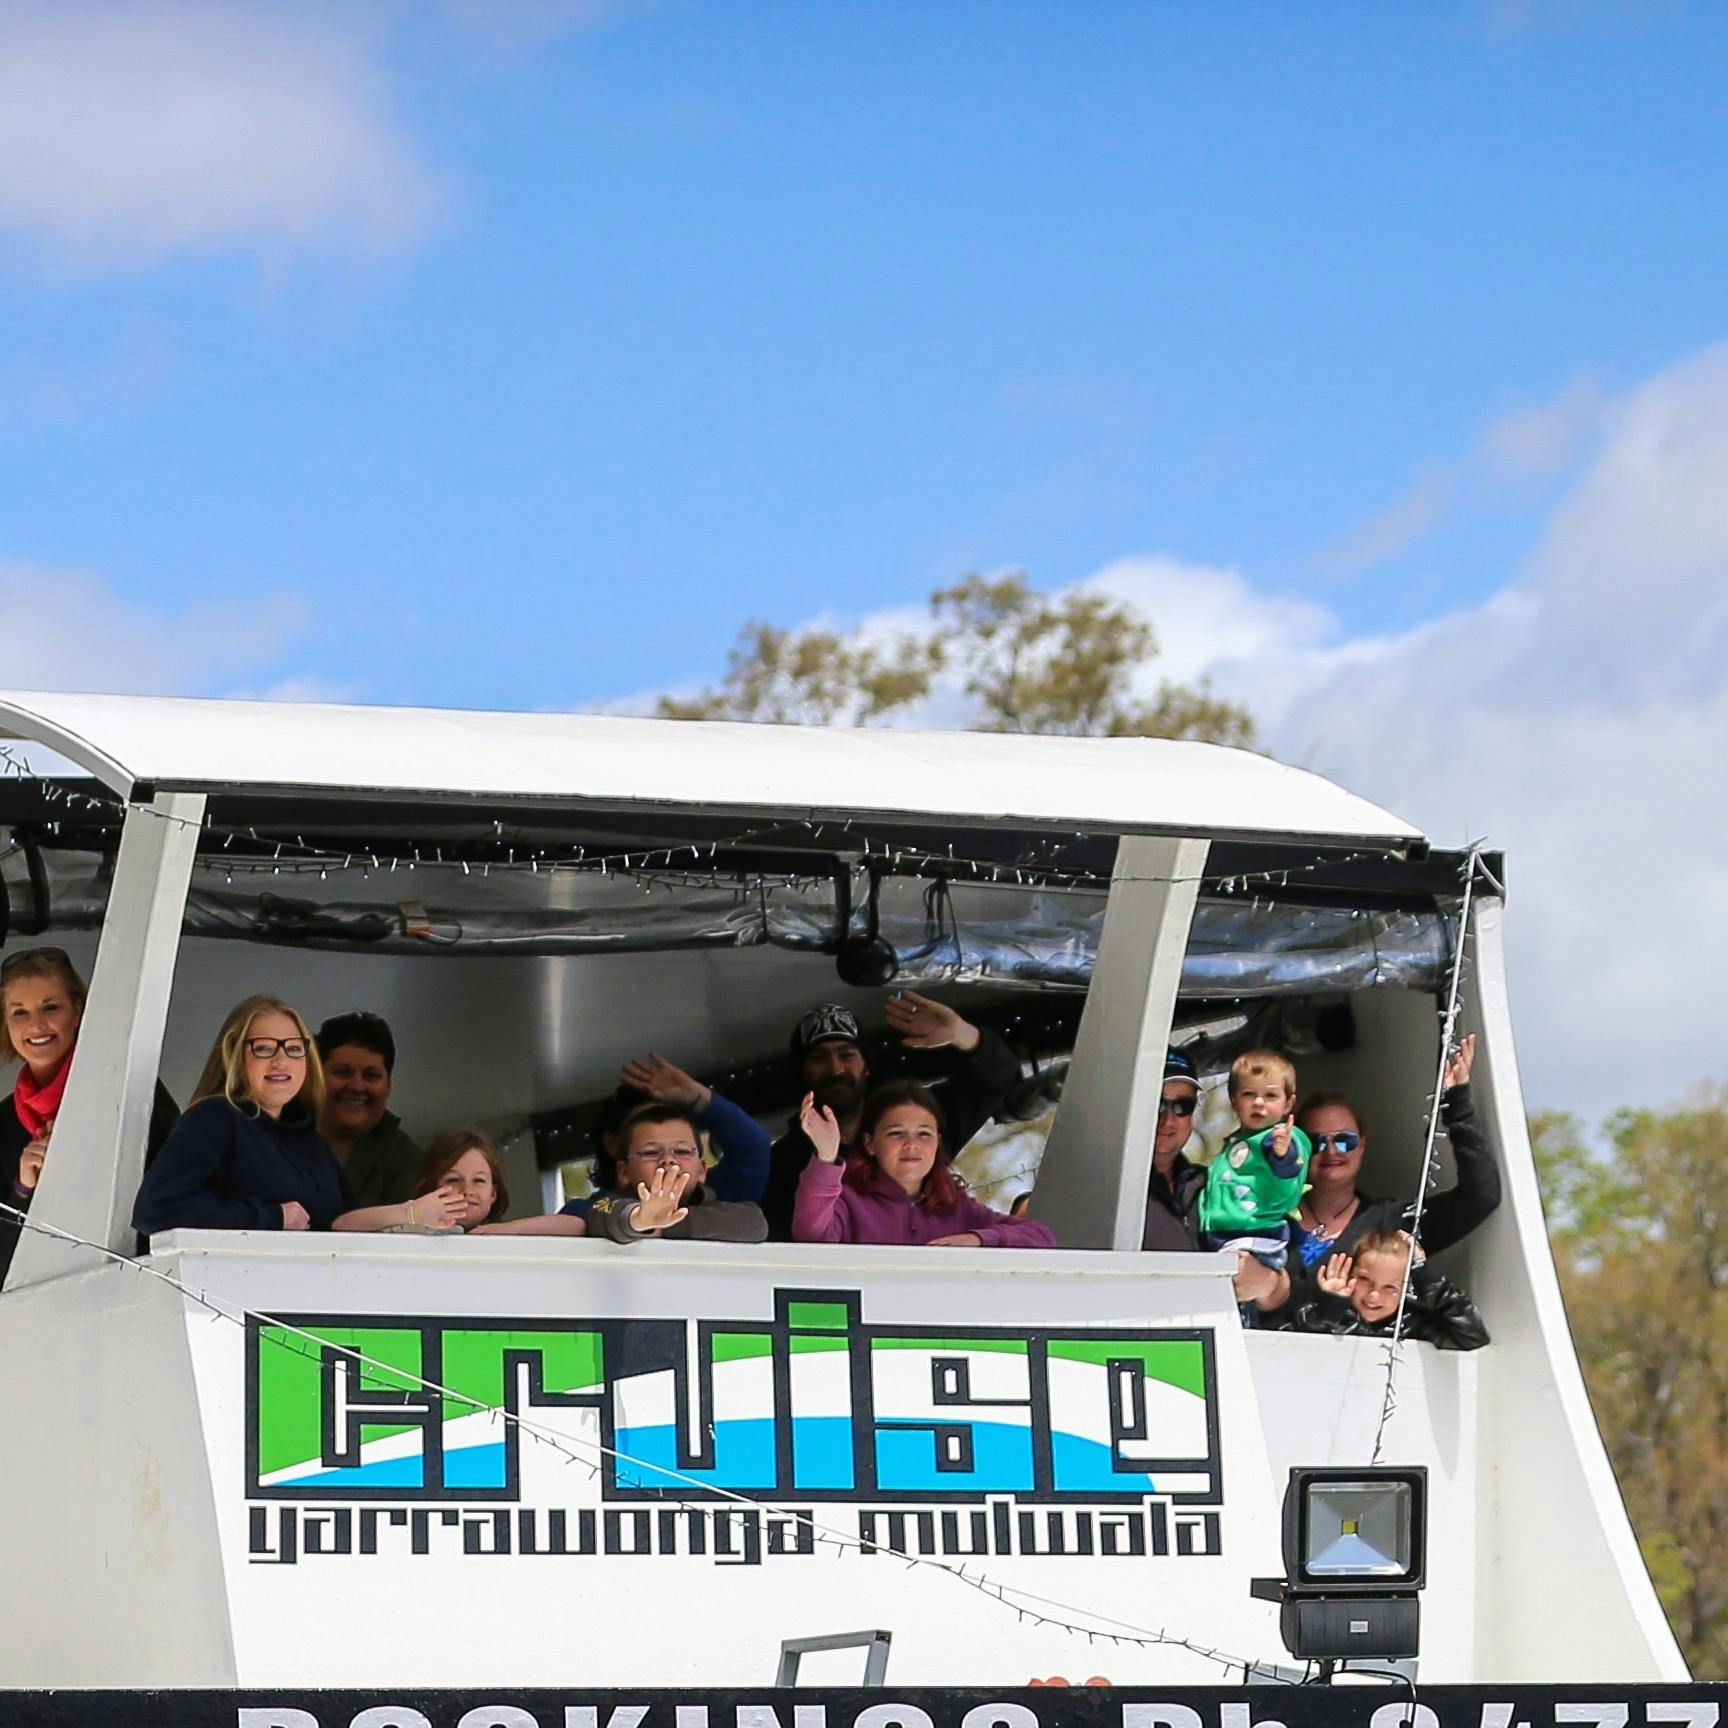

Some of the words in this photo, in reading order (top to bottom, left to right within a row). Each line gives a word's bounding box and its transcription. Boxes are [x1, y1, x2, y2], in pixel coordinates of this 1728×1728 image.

[245, 1287, 1224, 1506] cruise
[248, 1505, 814, 1566] yarrawonga
[859, 1500, 1222, 1556] mulwala
